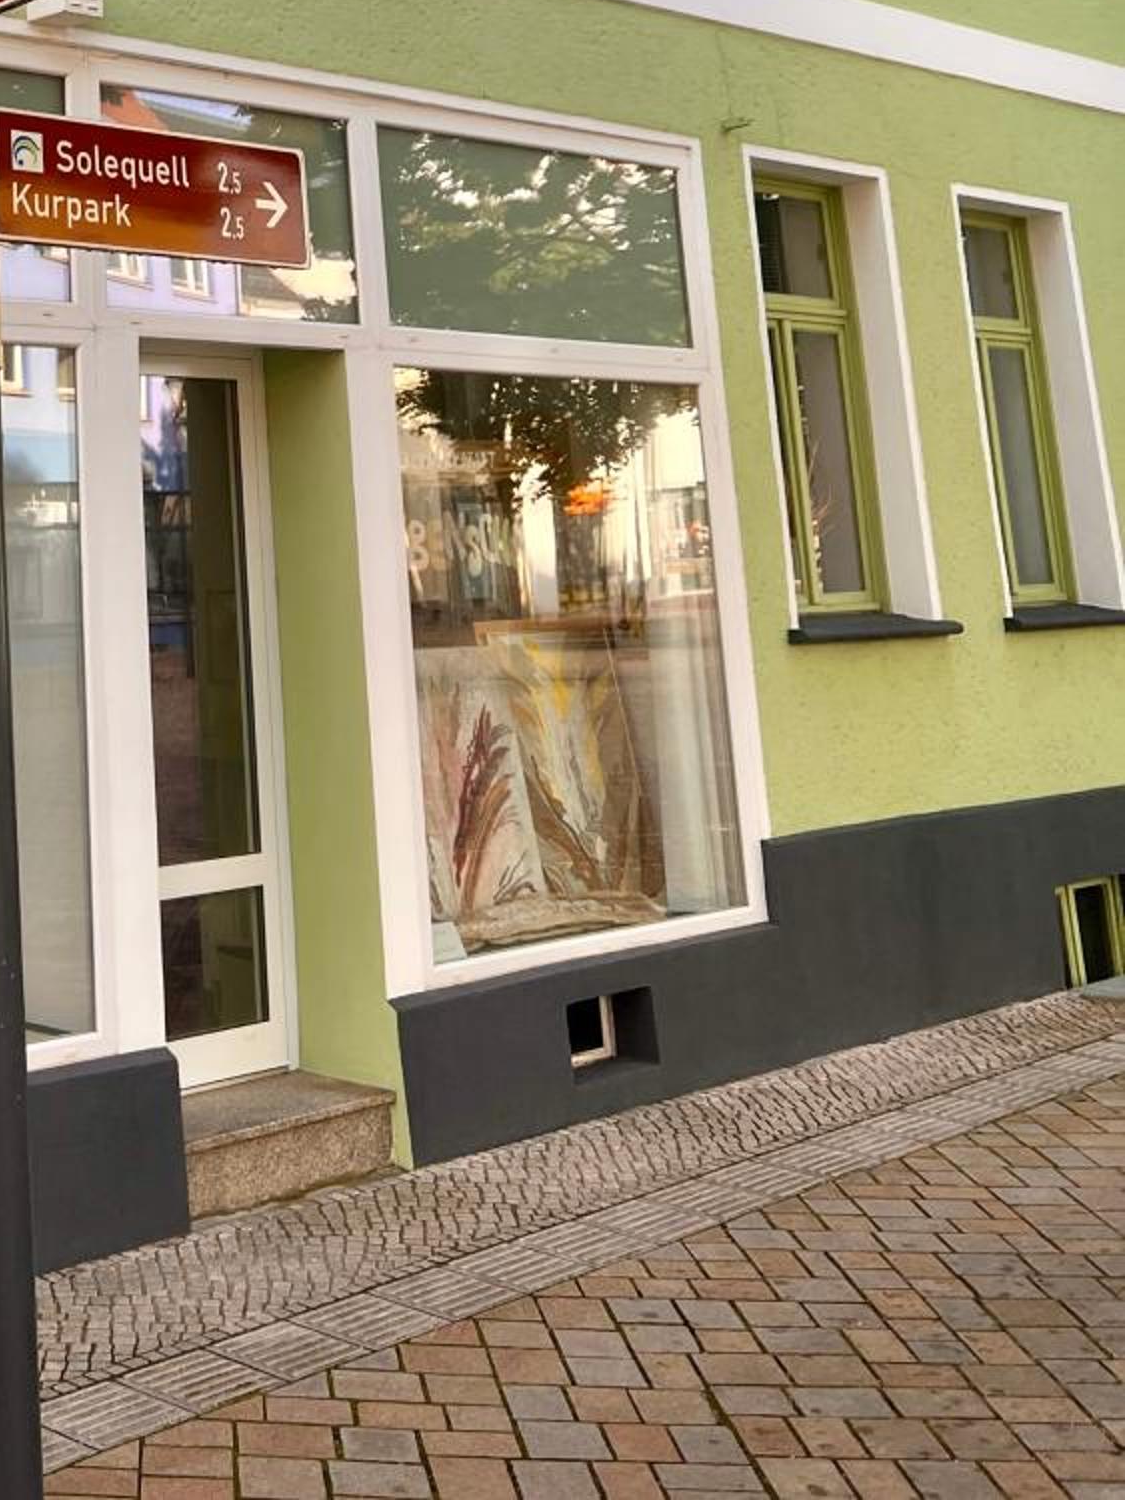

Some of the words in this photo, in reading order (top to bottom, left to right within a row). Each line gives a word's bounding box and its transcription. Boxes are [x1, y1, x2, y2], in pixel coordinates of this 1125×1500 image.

[56, 140, 190, 188] Solequell
[217, 162, 242, 195] 2.5
[11, 181, 132, 228] Kurpark
[219, 207, 244, 240] 2.5
